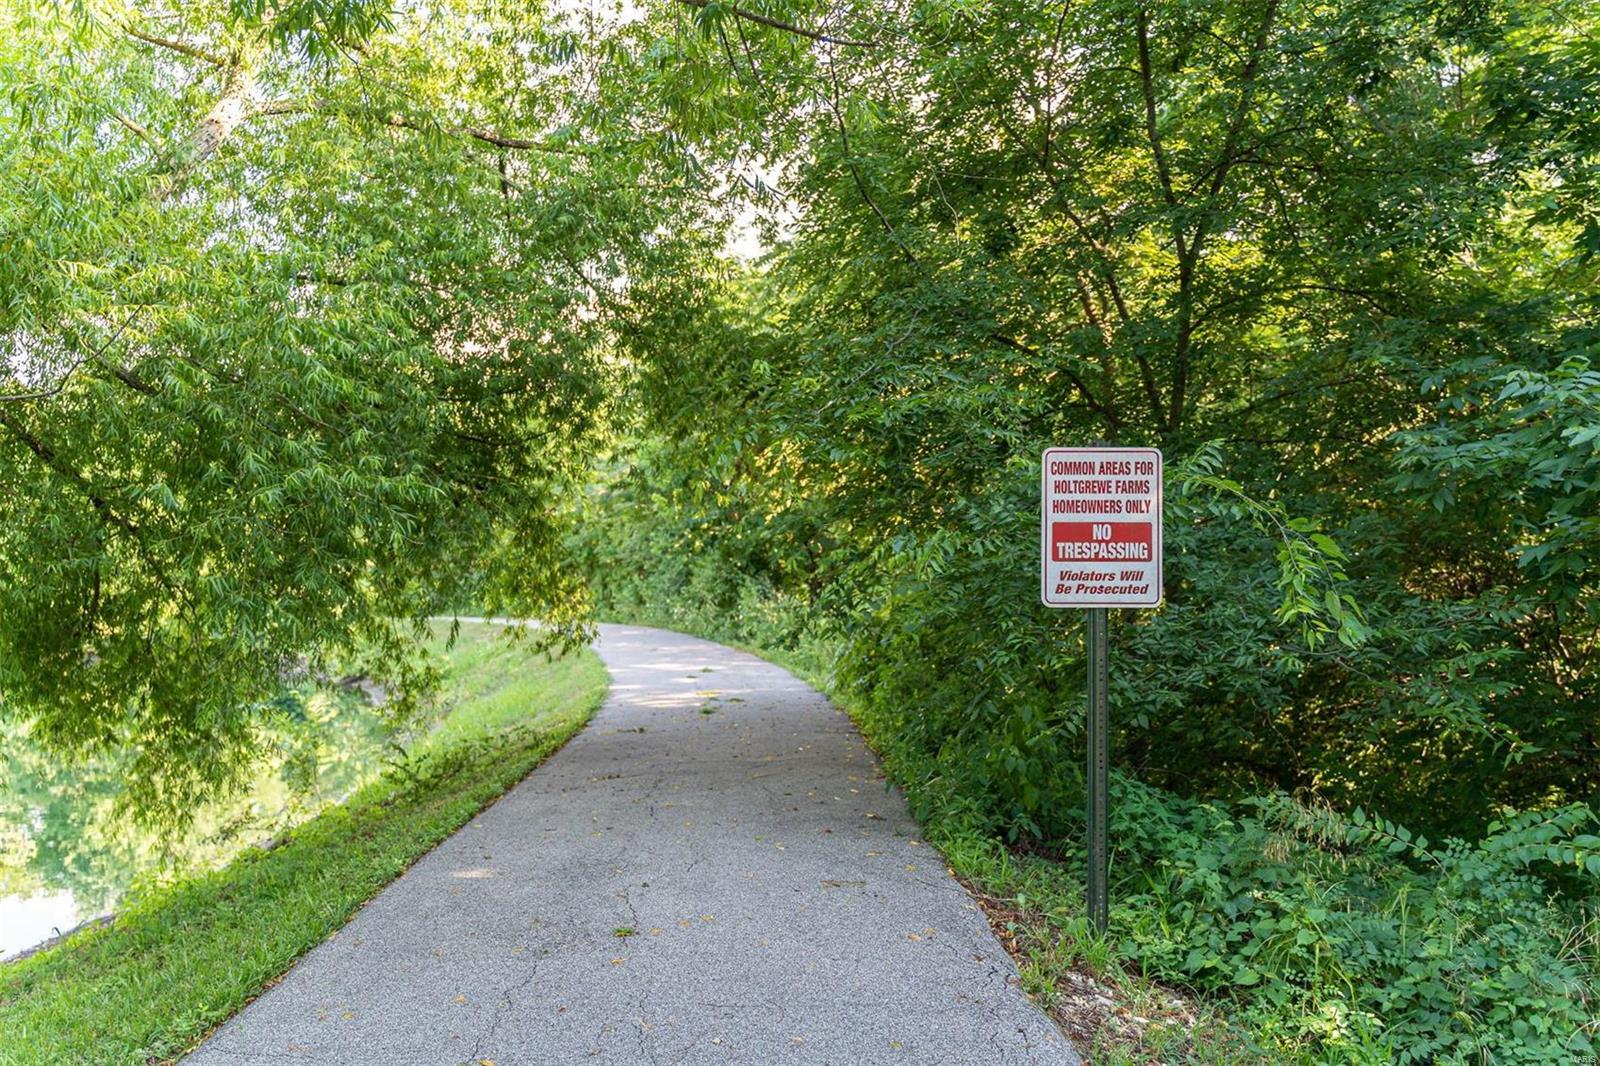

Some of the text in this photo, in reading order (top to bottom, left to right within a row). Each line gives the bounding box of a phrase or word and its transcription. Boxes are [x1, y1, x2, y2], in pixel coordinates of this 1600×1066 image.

[1051, 461, 1153, 475] COMMON AREAS FOR
[1054, 480, 1150, 494] HOLTGREWE FARMS
[1053, 500, 1150, 514] HOMEOWNERS ONLY
[1093, 524, 1112, 540] NO
[1057, 542, 1148, 559] TRESPASSING
[1060, 571, 1144, 581] Violators Will
[1056, 584, 1149, 594] Be Prosecuted
